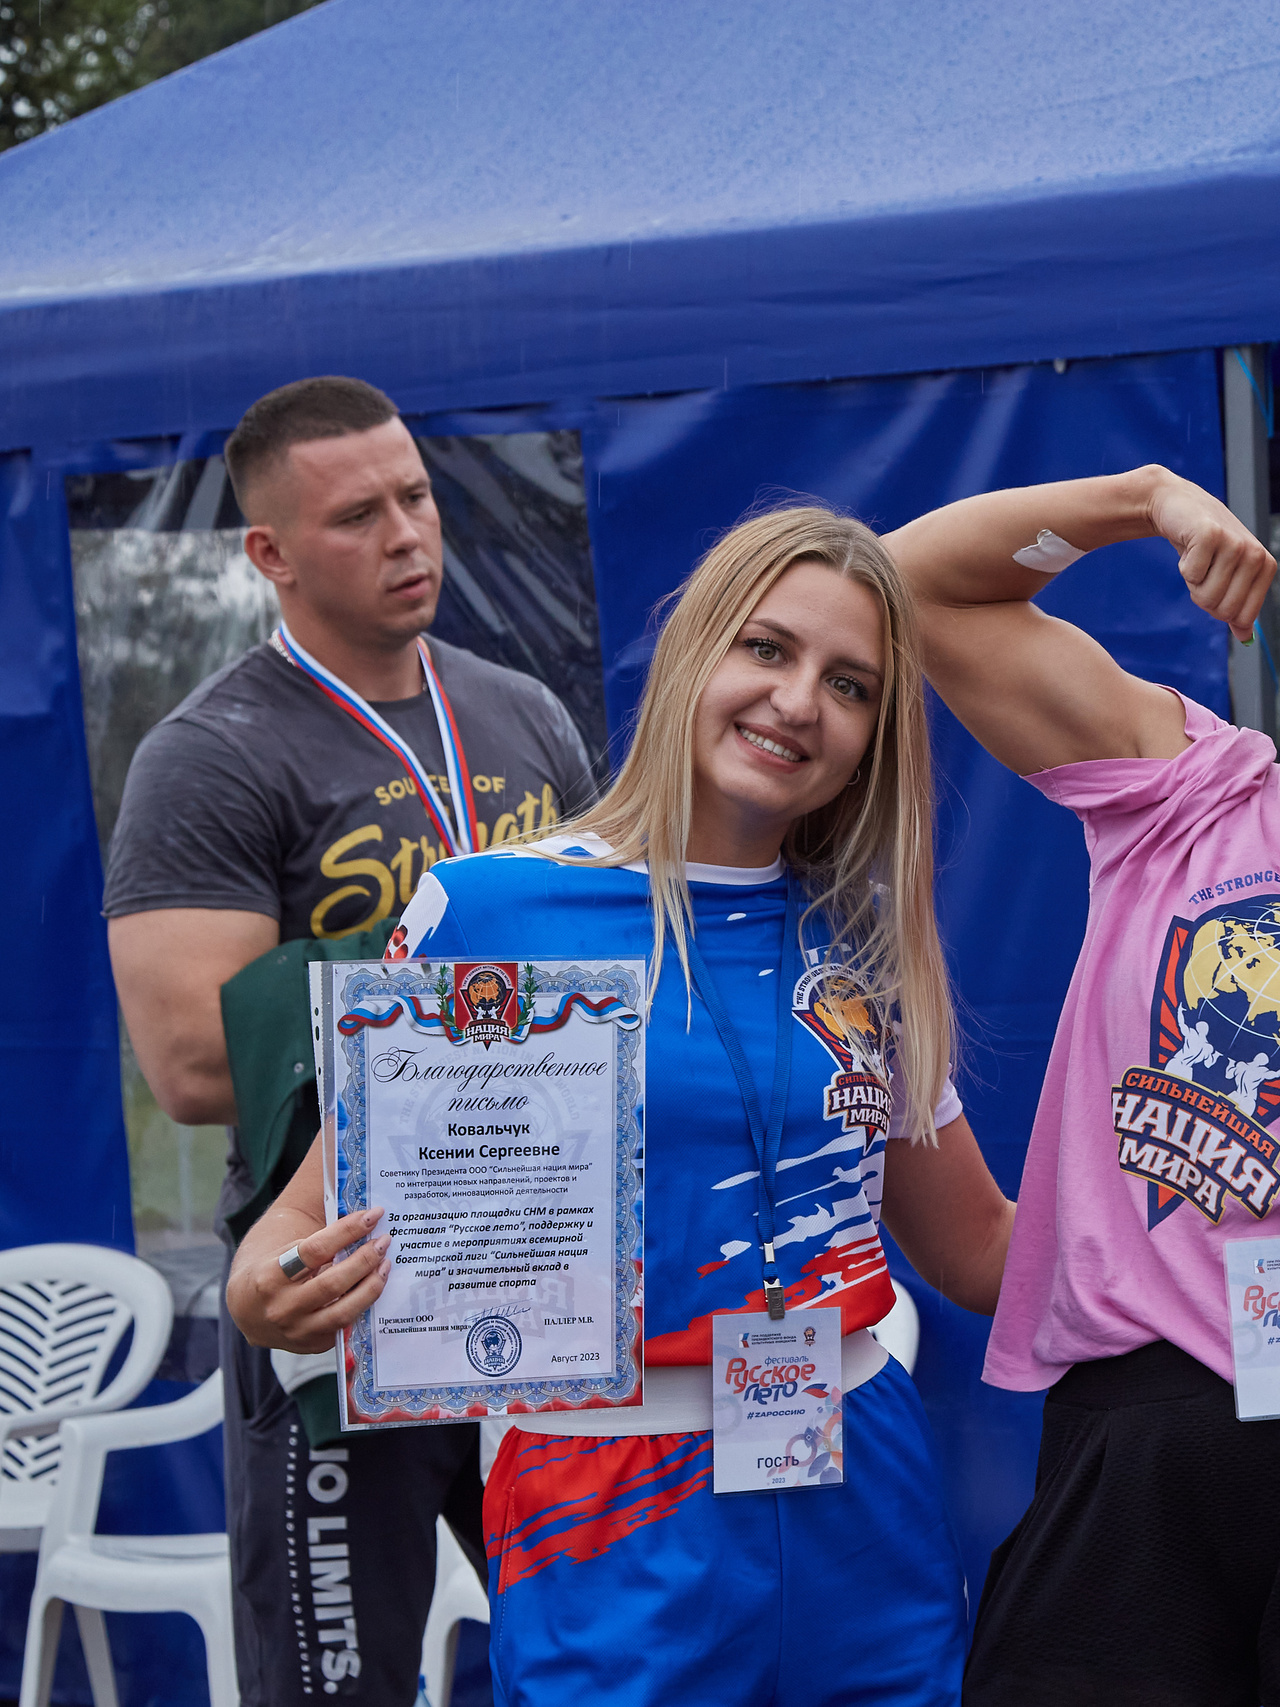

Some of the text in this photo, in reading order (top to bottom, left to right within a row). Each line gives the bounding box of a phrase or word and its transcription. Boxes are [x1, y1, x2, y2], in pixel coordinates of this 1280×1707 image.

[374, 775, 505, 806] SOUCE OF
[1189, 887, 1215, 905] THE
[467, 1024, 508, 1036] НАЦИЯ
[475, 1033, 500, 1041] МИРА
[371, 1046, 607, 1092] Благодарственное
[448, 1093, 529, 1112] письмо
[850, 1108, 887, 1131] МИРА
[1125, 1071, 1275, 1159] СИЛЬНЕЙШАЯ
[448, 1122, 530, 1138] Ковальчук
[419, 1143, 560, 1161] Ксении Сергеевне
[1112, 1092, 1278, 1212] НАЦИЯ
[380, 1169, 420, 1178] Советнику
[422, 1167, 466, 1177] Президента
[469, 1166, 487, 1174] ООО
[489, 1165, 540, 1173] “Сильнейшая
[569, 1163, 592, 1172] мира”
[1119, 1138, 1221, 1215] МИРА
[407, 1179, 451, 1189] интеграции
[453, 1178, 477, 1186] новых
[479, 1176, 532, 1186] направлений,
[534, 1176, 569, 1185] проектов
[405, 1186, 568, 1200] разработок, инновационной деятельности
[388, 1213, 400, 1221] За
[403, 1211, 468, 1222] организацию
[471, 1209, 521, 1220] площадки
[524, 1207, 546, 1216] СНМ
[556, 1206, 594, 1217] рамках
[390, 1225, 446, 1237] фестиваля
[449, 1224, 490, 1234] “Русское
[493, 1221, 527, 1232] лето”,
[528, 1221, 585, 1232] поддержку
[400, 1241, 442, 1251] участие
[452, 1237, 527, 1249] мероприятиях
[529, 1233, 583, 1245] всемирной
[396, 1249, 588, 1265] богатырской лиги “Сильнейшая нация
[415, 1268, 446, 1278] мира”
[448, 1268, 454, 1276] и
[456, 1263, 530, 1275] значительный
[532, 1263, 560, 1273] вклад
[448, 1278, 537, 1292] развитие спорта
[378, 1314, 594, 1326] Президент ООО ПАЛЛЕР М.В.
[378, 1323, 472, 1336] «Сильнейшая нация мира»
[551, 1352, 600, 1364] Август 2023
[765, 1355, 809, 1366] фестиваль
[725, 1357, 816, 1394] Русское
[757, 1456, 800, 1468] ГОСТЬ
[307, 1516, 362, 1694] LIMITS.
